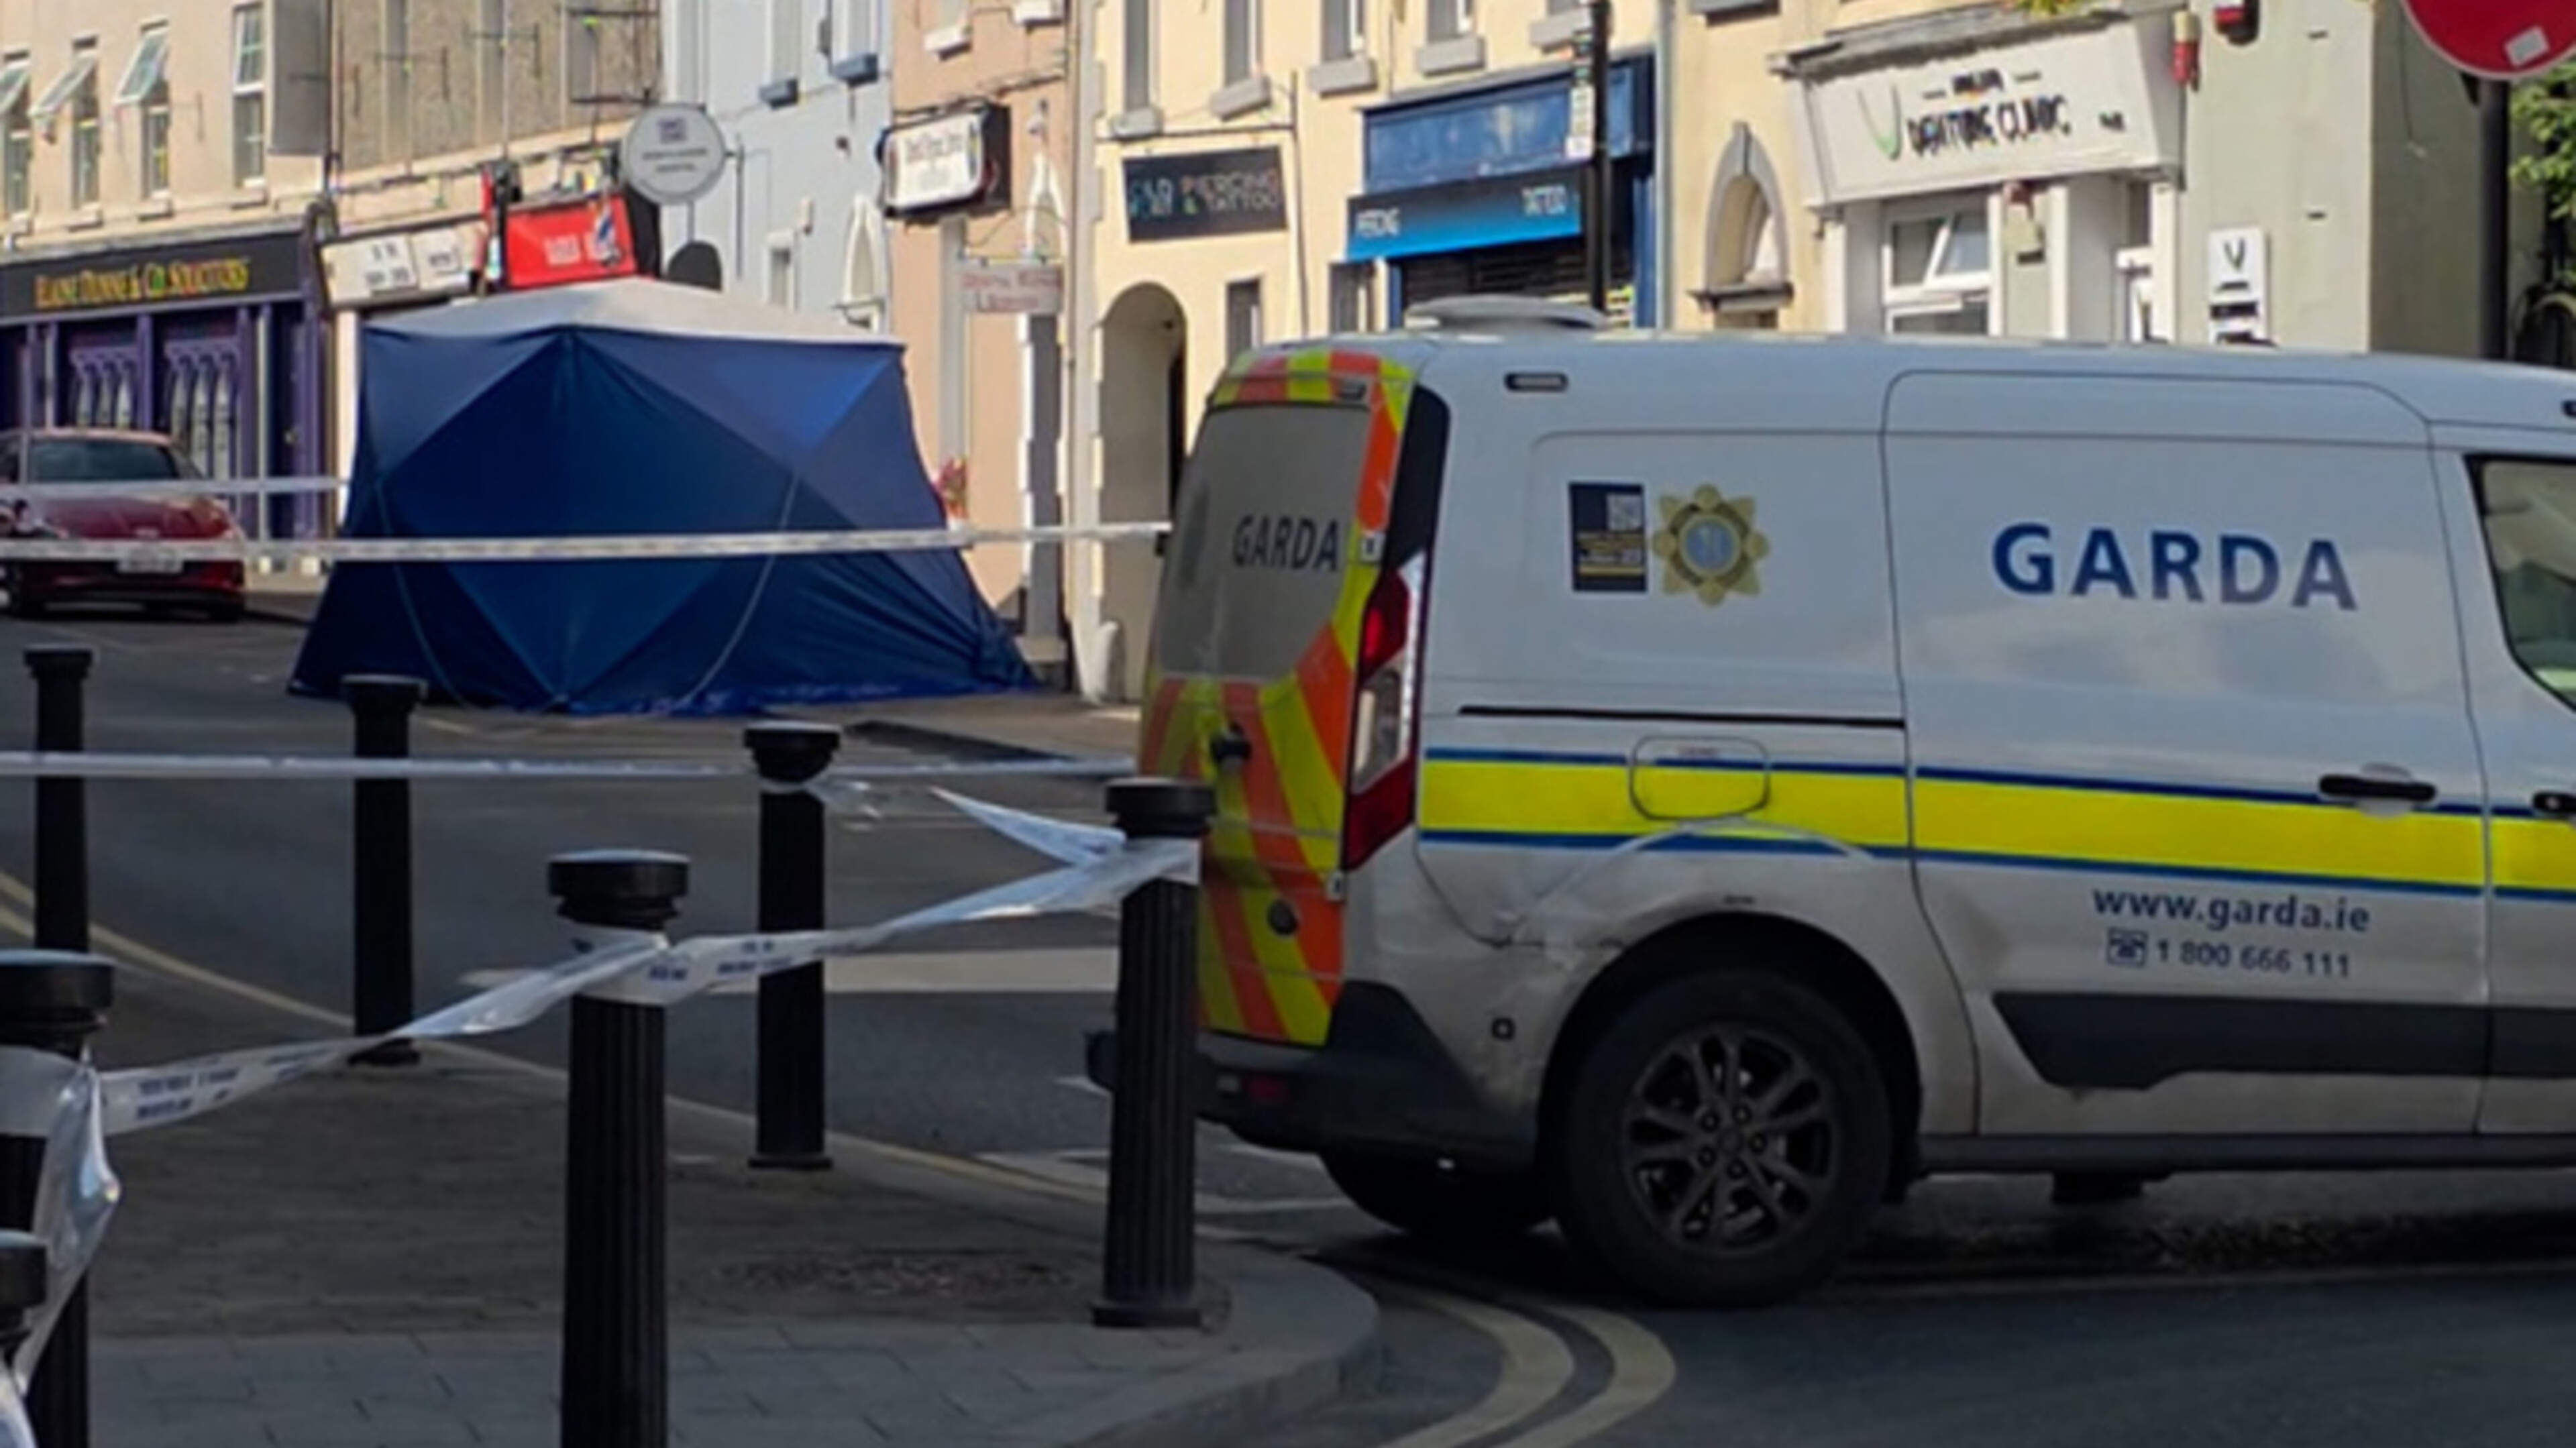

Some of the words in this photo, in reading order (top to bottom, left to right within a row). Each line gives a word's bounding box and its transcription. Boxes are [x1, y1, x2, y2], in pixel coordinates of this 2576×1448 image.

[1233, 514, 1338, 571] GARDA
[1992, 522, 2358, 611] GARDA
[2092, 889, 2371, 932] www.garda.ie
[2157, 940, 2169, 963] 1
[2180, 941, 2232, 967] 800
[2241, 944, 2291, 974] 666
[2303, 952, 2349, 978] 111
